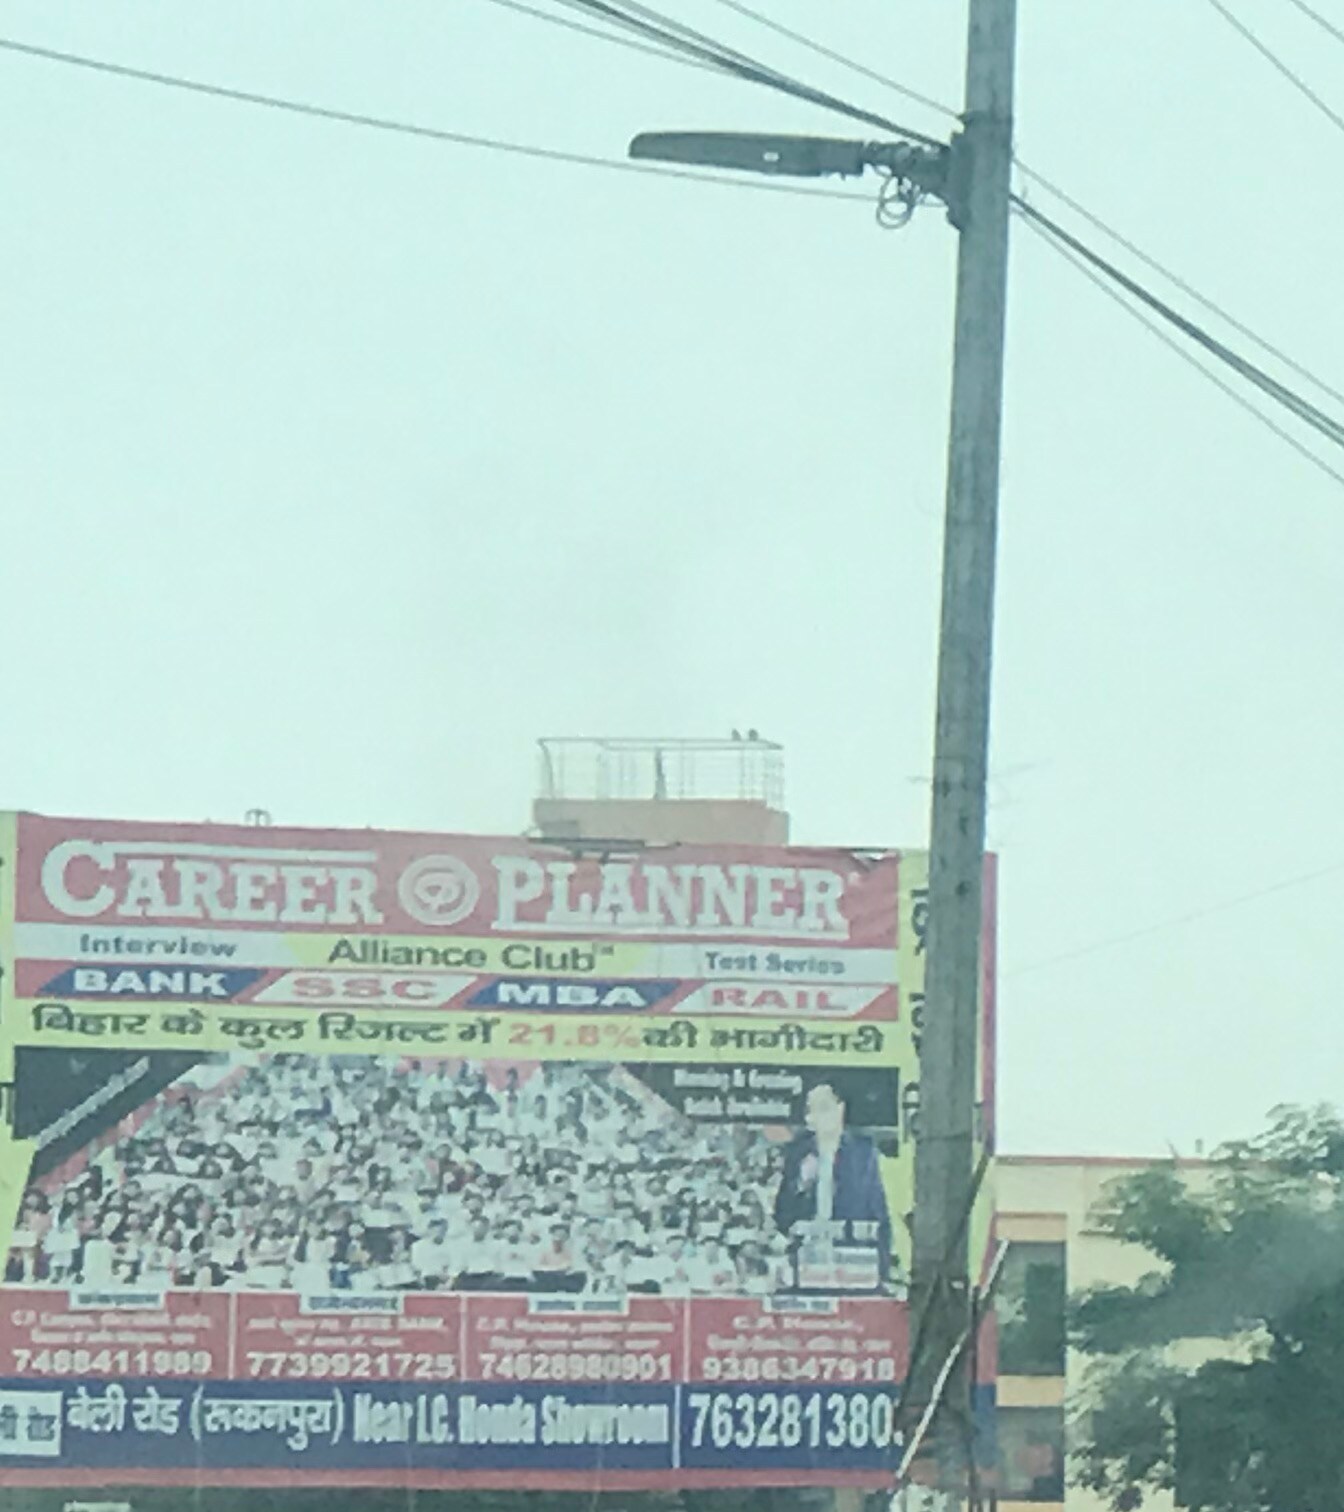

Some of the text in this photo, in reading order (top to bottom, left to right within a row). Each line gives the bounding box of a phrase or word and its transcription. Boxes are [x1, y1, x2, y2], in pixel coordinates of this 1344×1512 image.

[41, 839, 385, 927] CAREER
[490, 855, 851, 940] PLANNER
[79, 933, 238, 959] Interview
[328, 938, 487, 968] Alliance
[704, 950, 846, 975] Test Series
[73, 968, 228, 996] BANK
[293, 978, 438, 1001] SSC
[499, 983, 648, 1008] MBA
[711, 987, 849, 1012] RAIL
[31, 1003, 150, 1034] बिहार
[160, 1008, 206, 1035] के
[219, 1016, 306, 1049] कुल
[709, 1023, 885, 1052] भागीदारी
[133, 1386, 183, 1436] रोड
[353, 1392, 414, 1443] Near
[541, 1395, 669, 1445] Showroom
